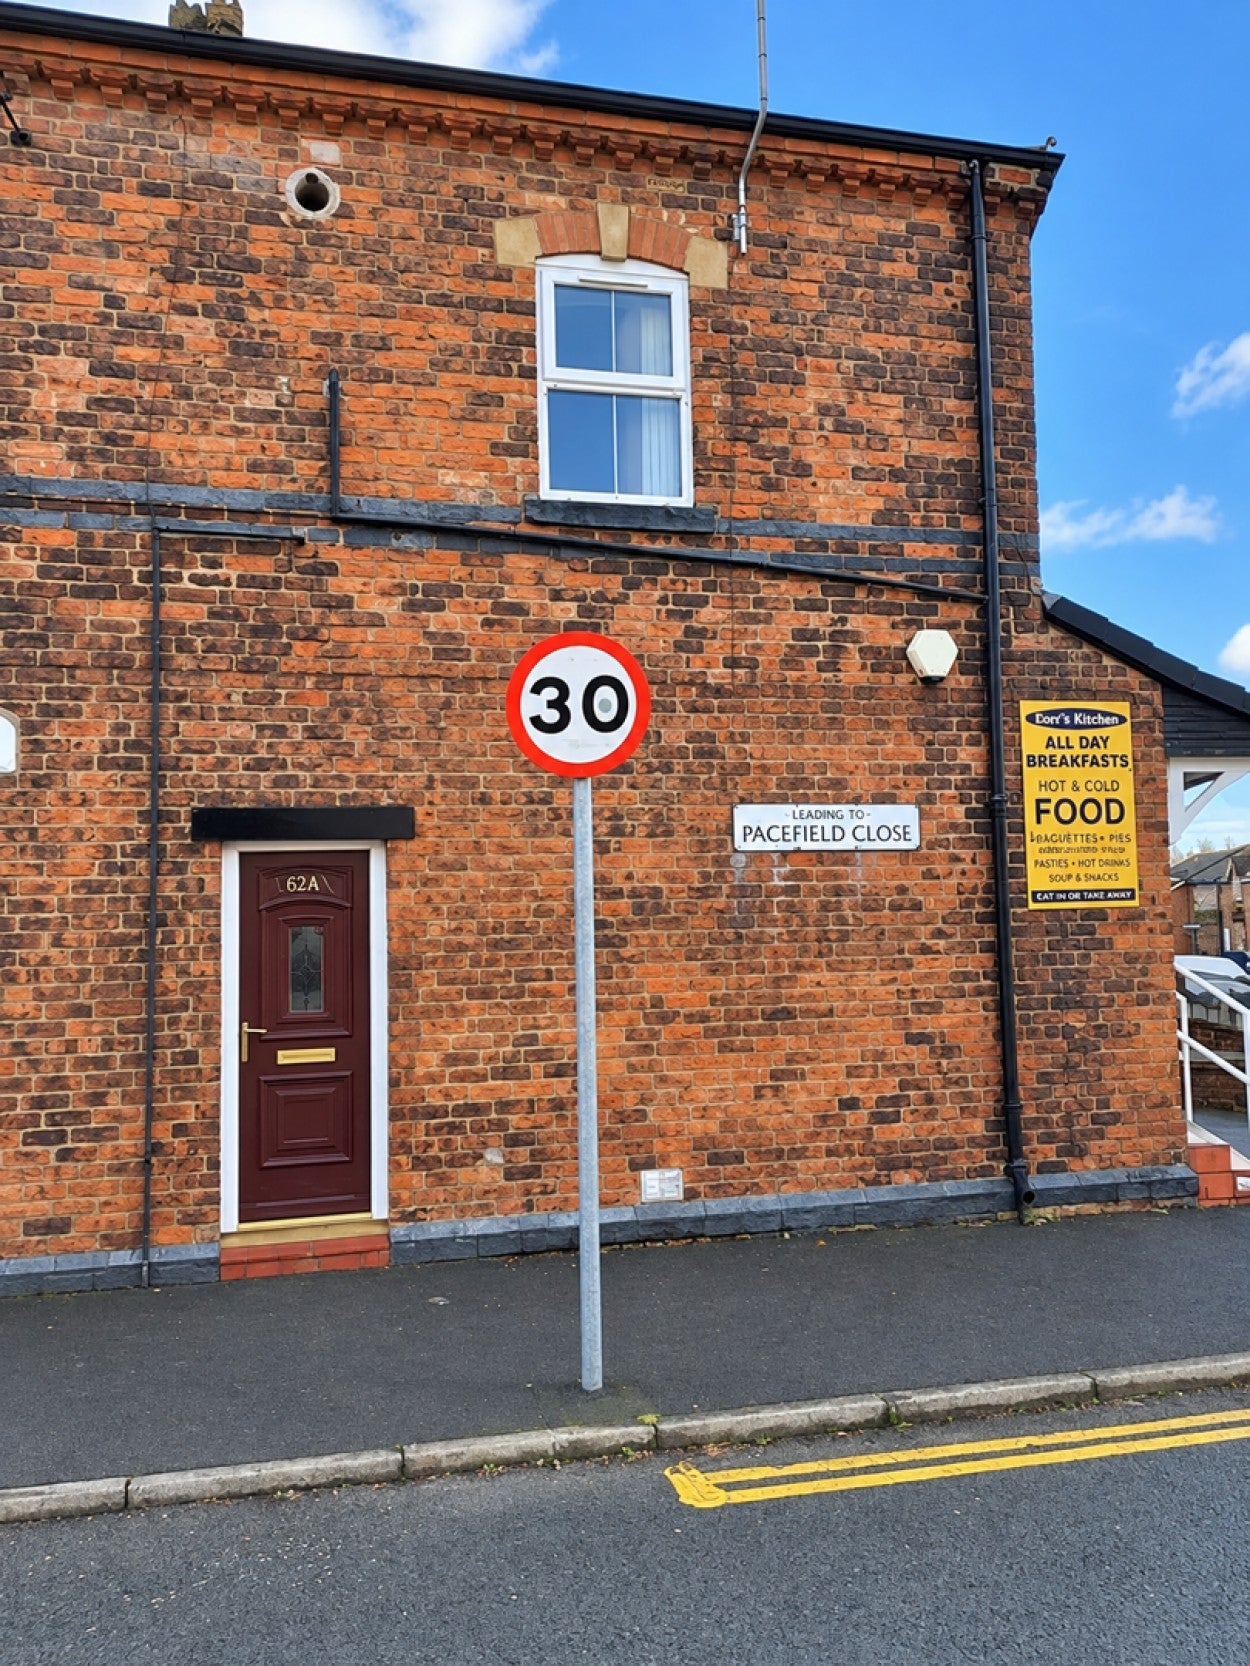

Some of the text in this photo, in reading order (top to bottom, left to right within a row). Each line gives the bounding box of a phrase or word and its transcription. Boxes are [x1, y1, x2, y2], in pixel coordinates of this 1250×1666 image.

[529, 674, 629, 734] 30
[1074, 713, 1119, 725] Kitchen
[1046, 736, 1110, 749] ALL DAY
[1026, 754, 1129, 768] BREAKFASTS
[1039, 780, 1120, 792] HOT & COLD
[792, 810, 844, 820] LEADING
[1035, 798, 1126, 825] FOOD
[743, 825, 912, 842] PACEFIELD CLOSE
[1078, 859, 1096, 868] HOT
[286, 875, 320, 893] 62A
[1049, 874, 1073, 883] SOUP
[1036, 893, 1055, 901] EAT
